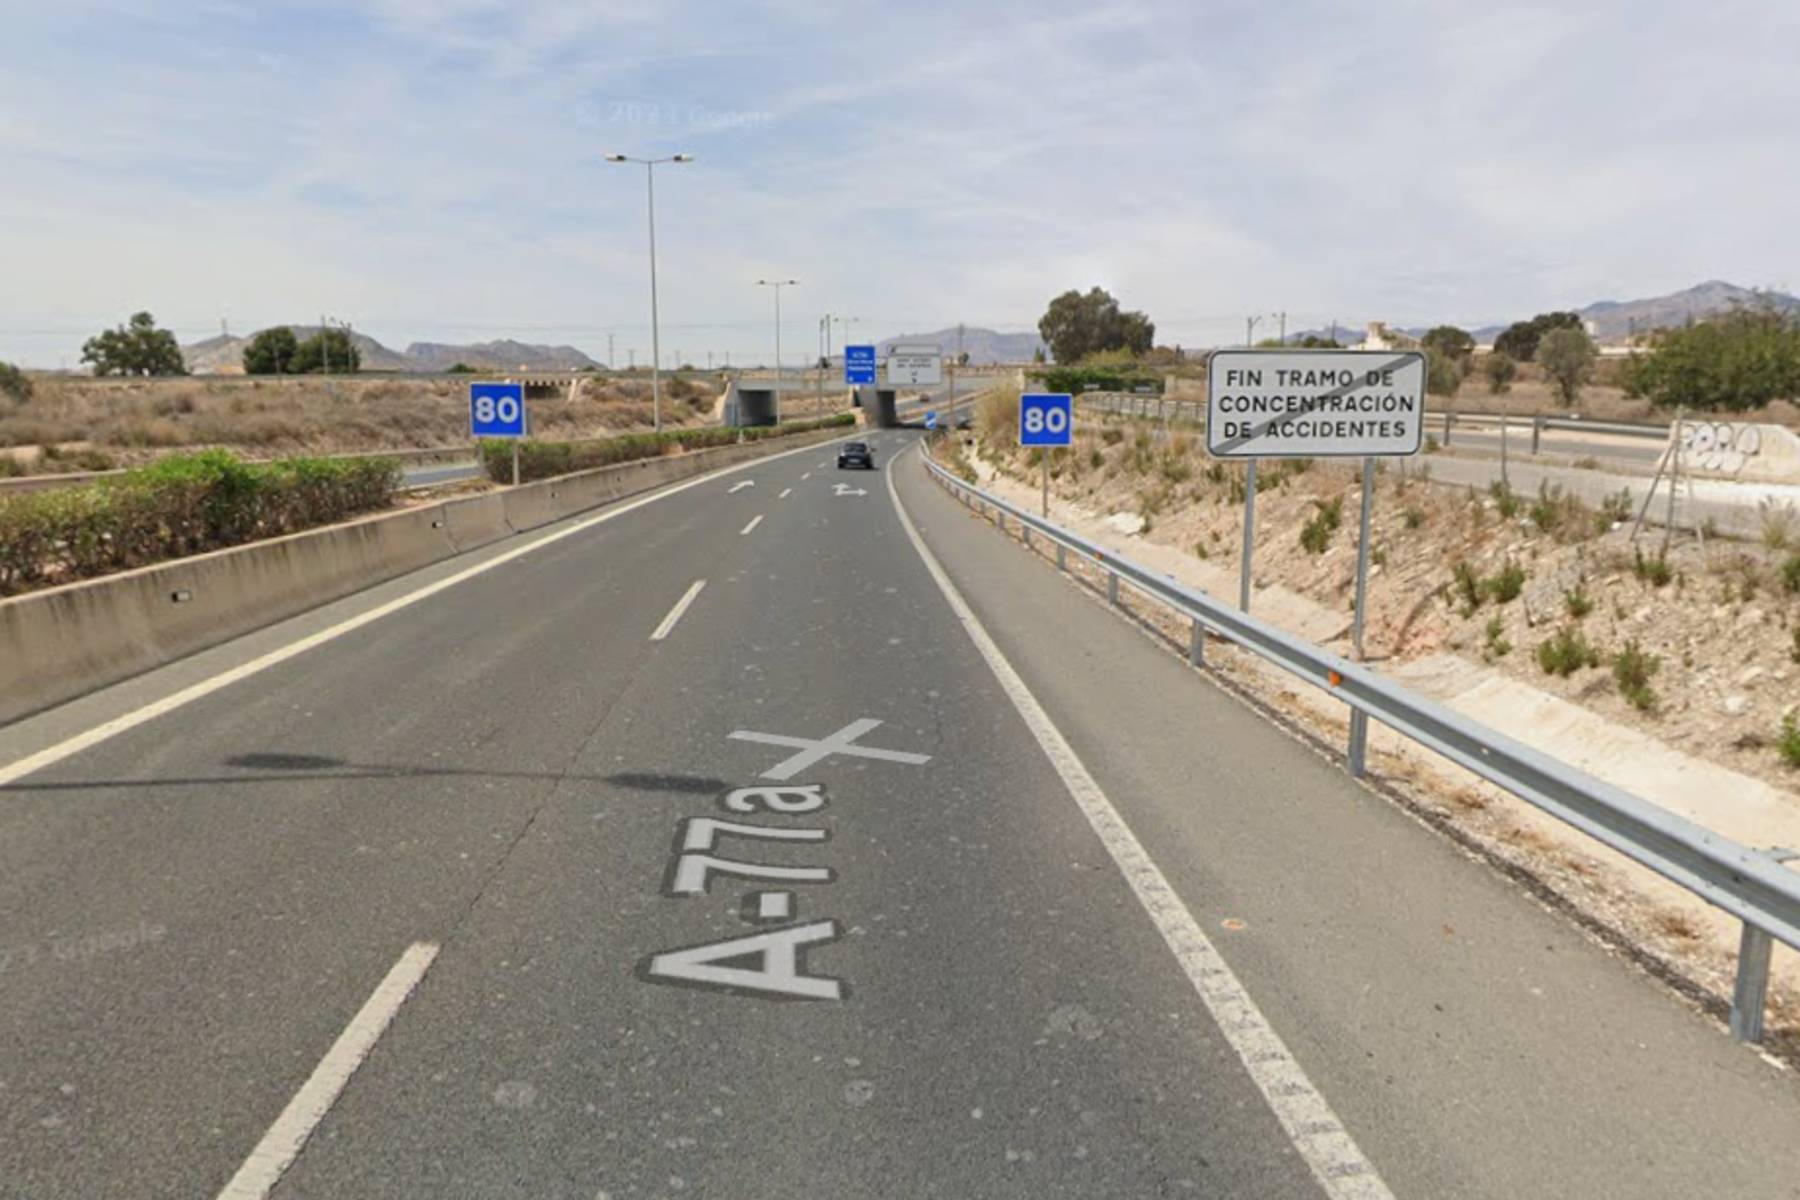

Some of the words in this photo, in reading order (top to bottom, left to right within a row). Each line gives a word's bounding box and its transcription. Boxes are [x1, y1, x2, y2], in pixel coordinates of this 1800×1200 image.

[1226, 370, 1262, 387] FIN
[1276, 370, 1353, 387] TRAMO
[1365, 370, 1393, 387] DE
[475, 396, 518, 424] 80
[1218, 393, 1413, 413] CONCENTRACIÓN
[1025, 406, 1067, 433] 80
[1223, 422, 1251, 438] DE
[1266, 421, 1406, 438] ACCIDENTES
